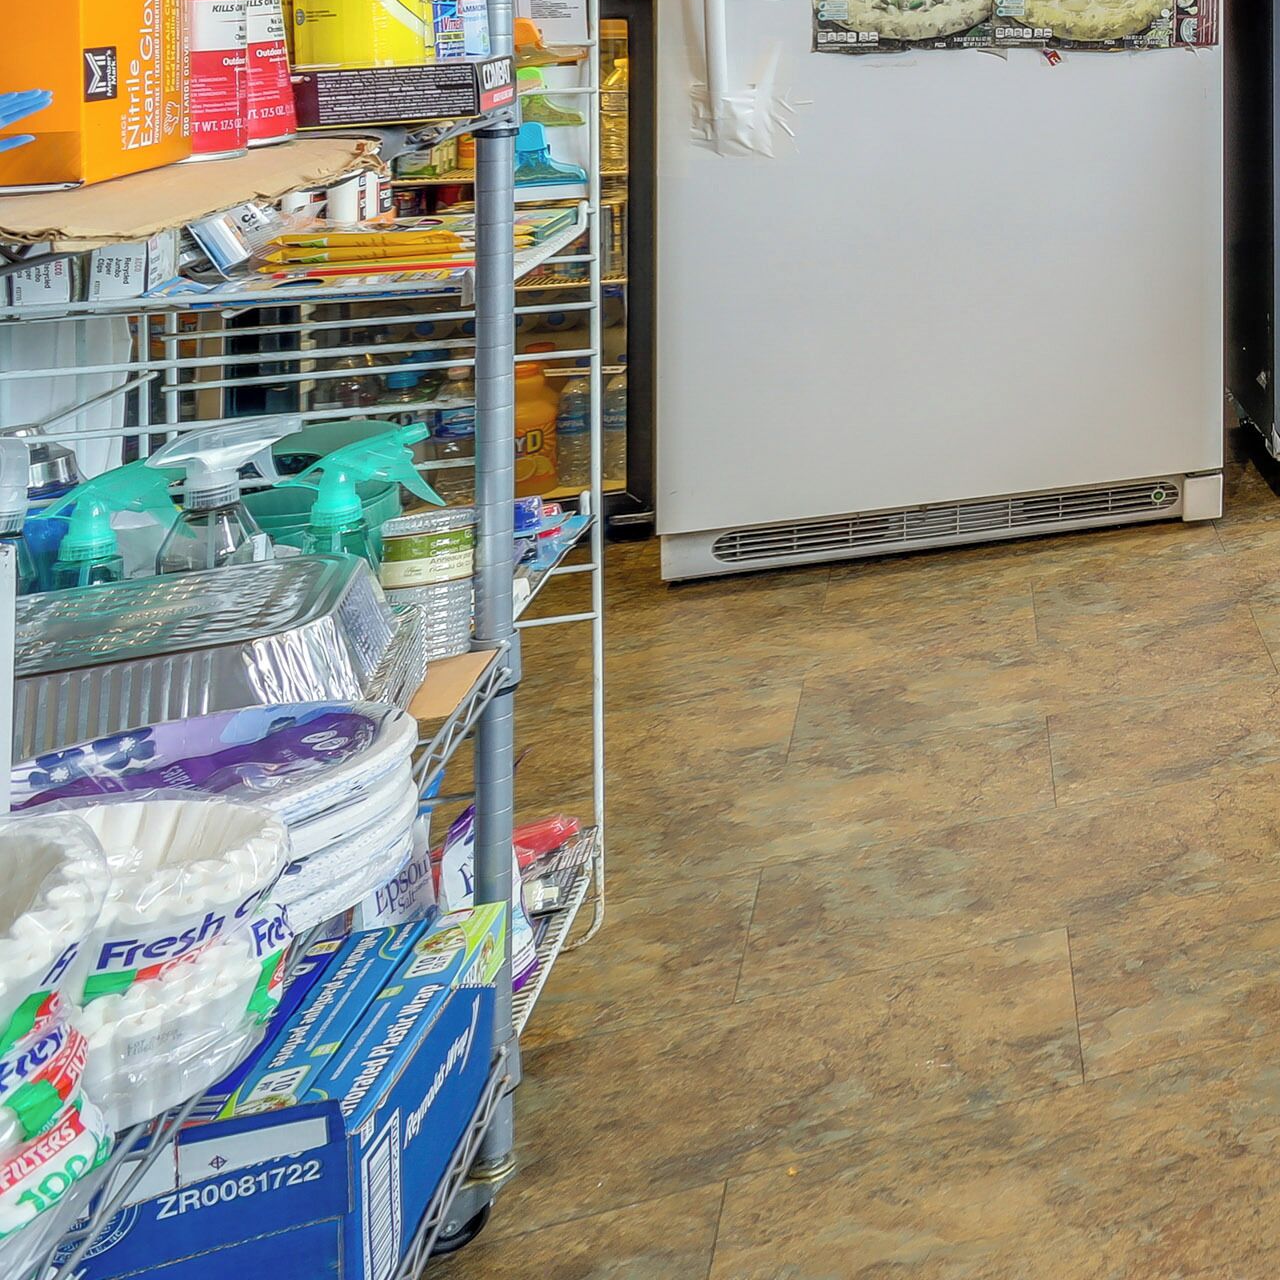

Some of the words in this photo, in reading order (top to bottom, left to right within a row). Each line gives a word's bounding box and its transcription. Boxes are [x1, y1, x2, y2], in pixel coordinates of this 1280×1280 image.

[127, 59, 140, 150] Nitrile
[140, 91, 152, 148] Exam
[96, 912, 225, 970] Fresh
[373, 1013, 413, 1061] Plastic
[403, 983, 444, 1018] Wrap
[1, 1119, 76, 1186] FILTERS
[16, 1155, 88, 1212] 100
[156, 1160, 322, 1220] ZR0081722
